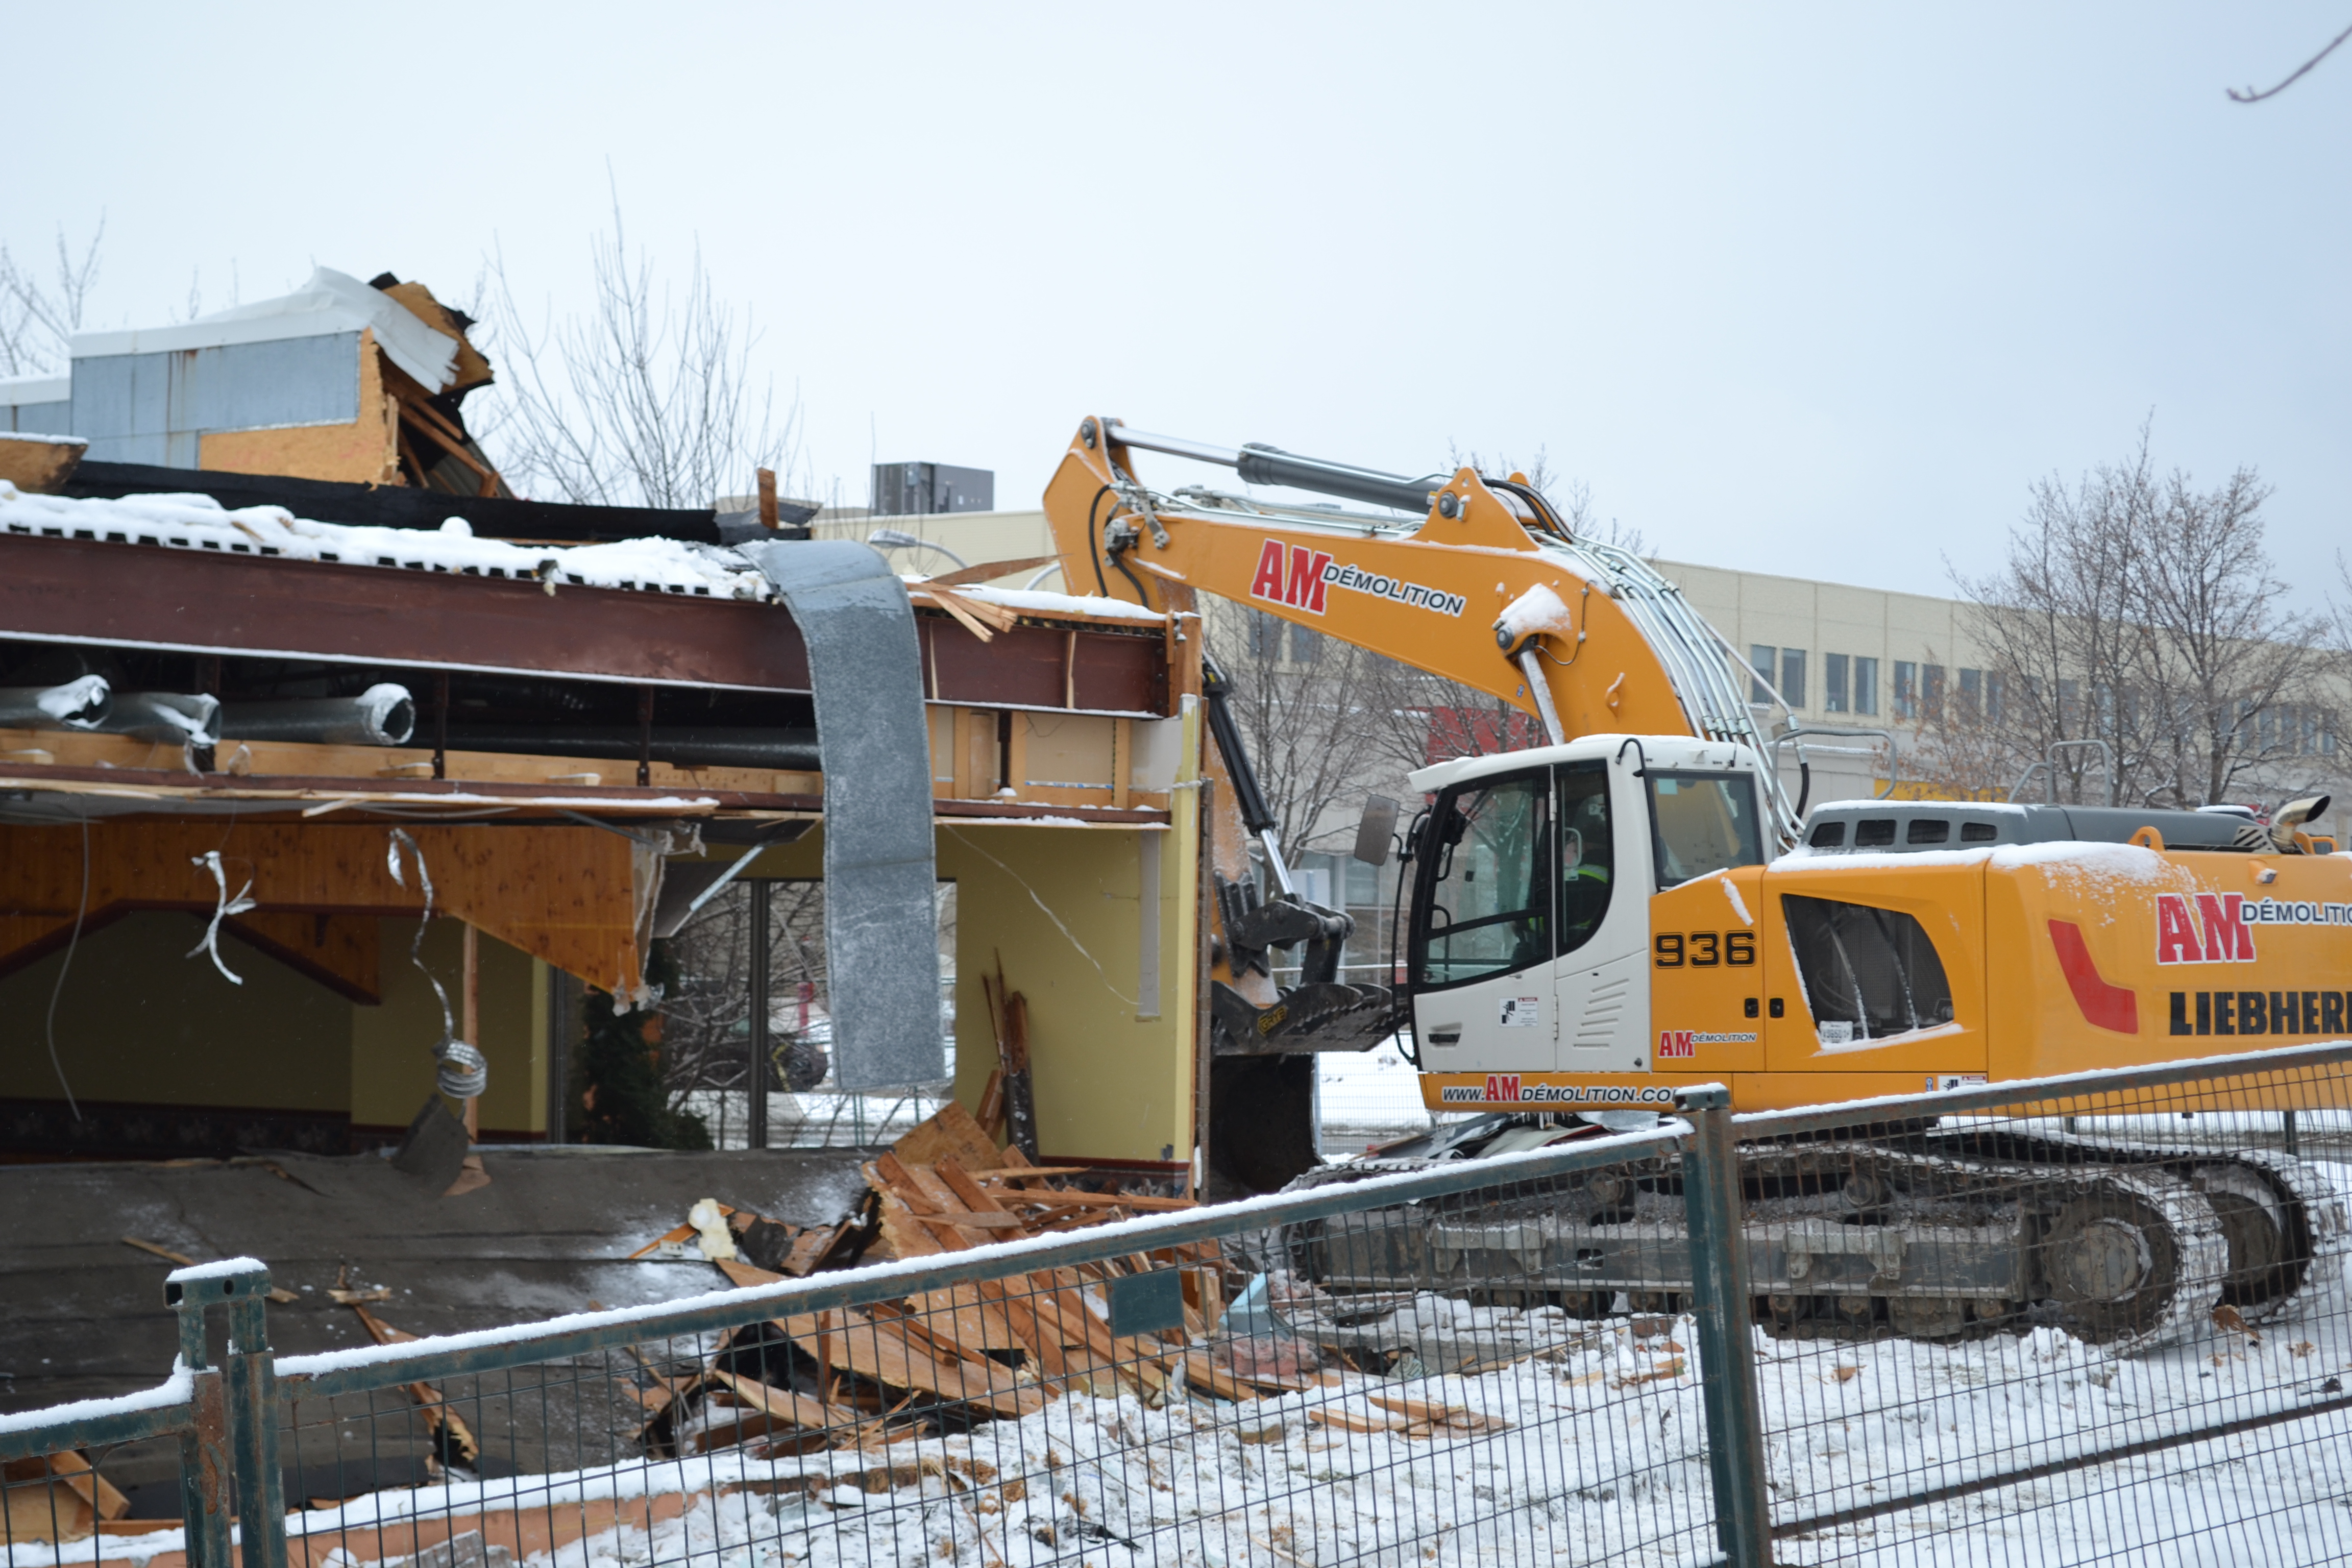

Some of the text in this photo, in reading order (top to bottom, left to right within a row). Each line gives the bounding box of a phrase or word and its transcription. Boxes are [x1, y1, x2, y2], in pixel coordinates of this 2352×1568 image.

[1251, 540, 1464, 614] AM DÉMOLITION
[2157, 894, 2255, 963] AM
[1655, 930, 1757, 969] 936
[2169, 991, 2352, 1035] LIEBHER
[1659, 1031, 1756, 1057] AM DÉMOLITION
[1442, 1075, 1677, 1102] WWW.AMDÉMOLITION.CO
